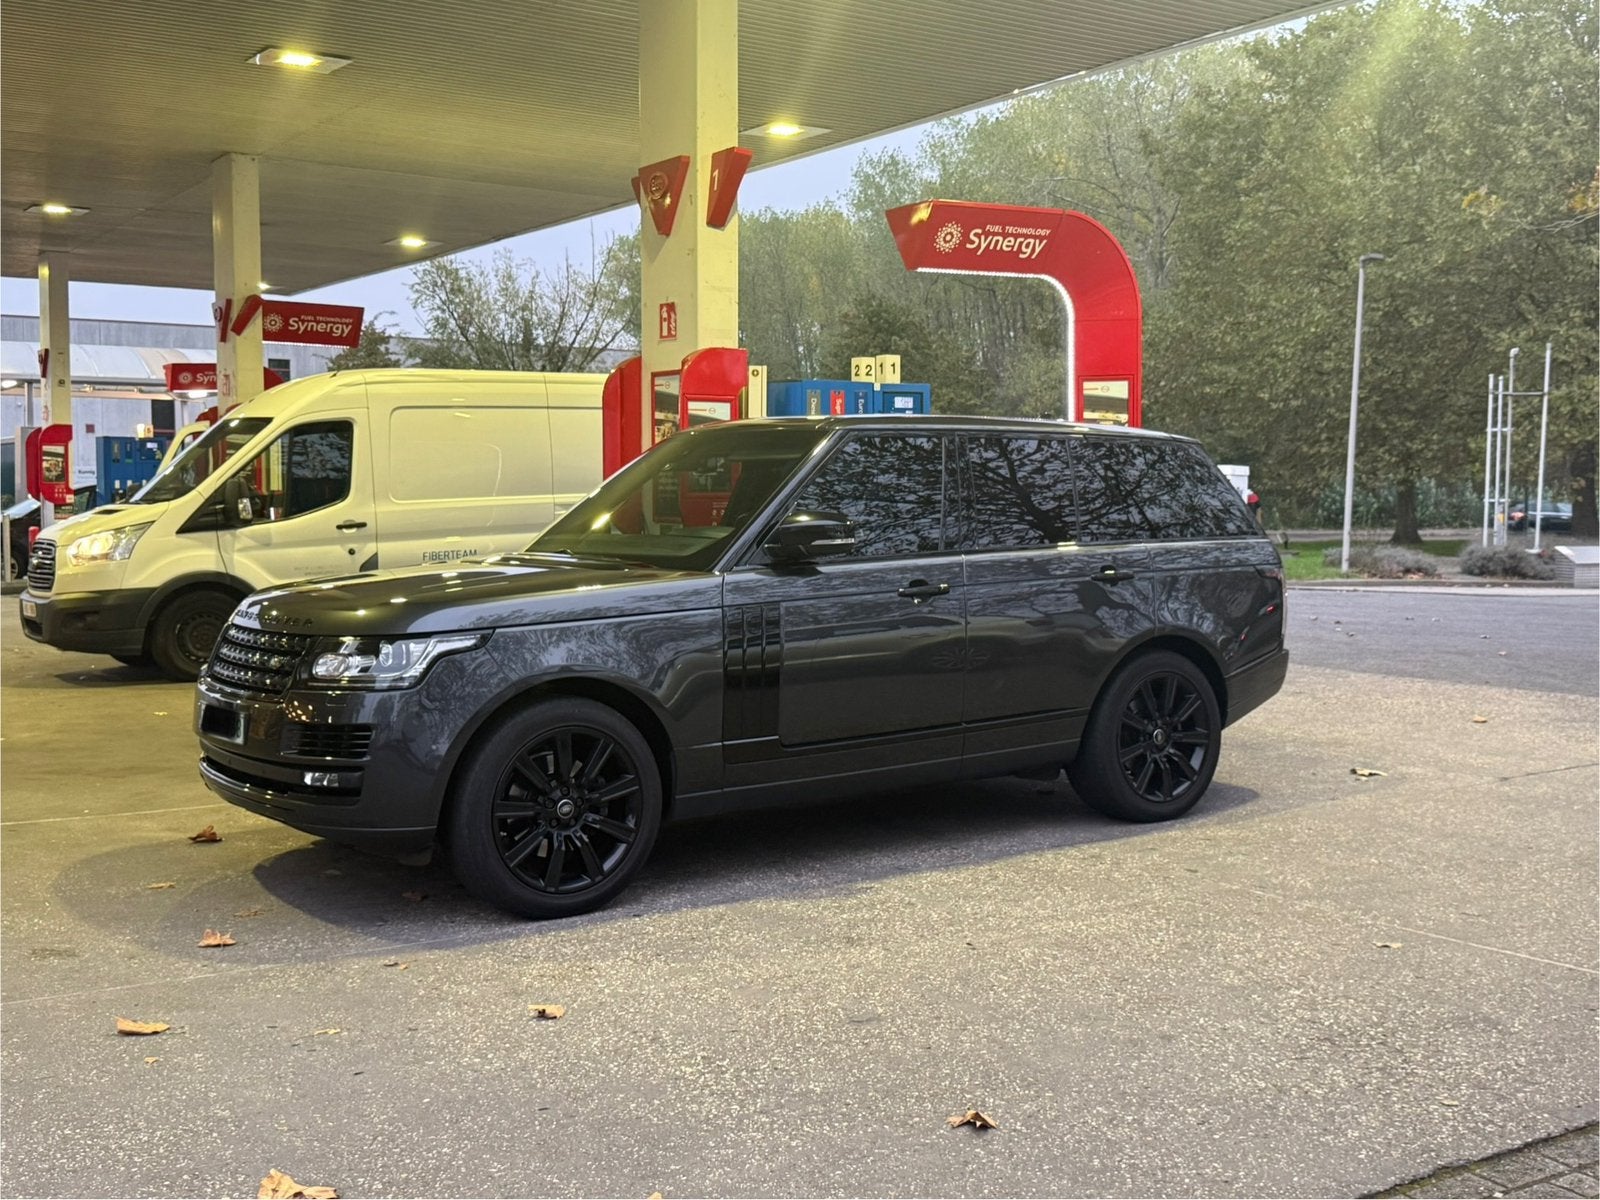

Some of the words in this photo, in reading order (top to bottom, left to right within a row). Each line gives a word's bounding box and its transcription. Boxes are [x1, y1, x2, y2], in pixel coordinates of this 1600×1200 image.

[712, 168, 719, 191] 1
[985, 224, 1003, 233] FUEL
[1005, 226, 1052, 237] TECHNOLOGY
[965, 228, 1048, 259] Synergy
[288, 317, 352, 337] Synergy
[854, 364, 860, 377] 2
[865, 364, 873, 377] 2
[879, 362, 884, 375] 1
[890, 362, 896, 375] 1
[195, 372, 217, 385] Syn
[422, 549, 478, 561] FIBERTEAM
